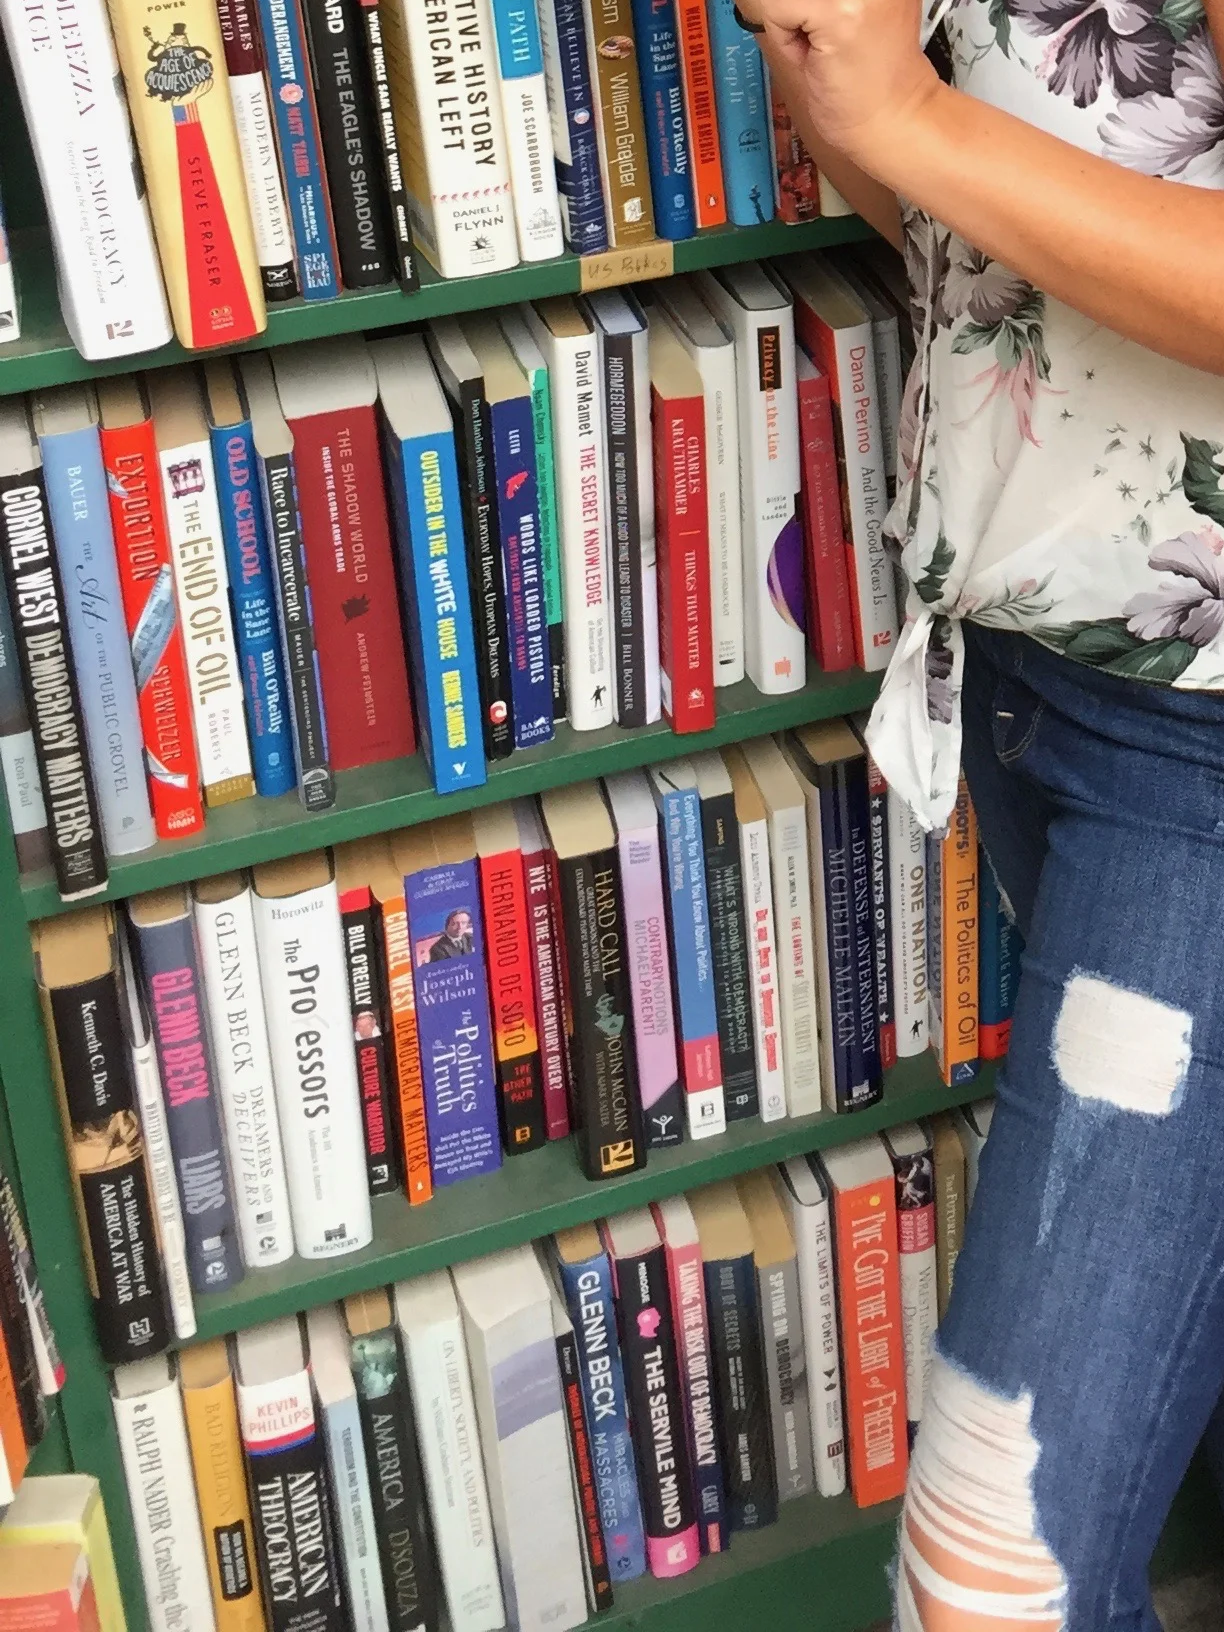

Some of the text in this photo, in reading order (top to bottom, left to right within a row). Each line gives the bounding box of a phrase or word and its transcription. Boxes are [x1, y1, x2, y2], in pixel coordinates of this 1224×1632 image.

[147, 1, 186, 13] POWER
[333, 48, 377, 251] THE EAGLE'S SHADOW
[437, 97, 465, 152] LEFT
[463, 64, 496, 168] HISTORY
[454, 216, 505, 232] FLYNN
[575, 350, 593, 437] David Mamet
[850, 345, 870, 454] Dana Perino
[2, 486, 59, 628] CORNEL WEST
[581, 446, 602, 607] THE SECRET KNOWLEDGE
[180, 500, 231, 705] THE END OF OIL
[26, 629, 94, 850] DEMOCRACY MATTERS
[271, 899, 325, 921] Horowitz
[152, 967, 210, 1107] GLENN BECK
[215, 913, 255, 1074] GLENN BECK
[100, 1183, 133, 1304] AMERICA AT WAR
[852, 1211, 897, 1471] I'VE GOT THE LIGHT of FREEDOM
[644, 1345, 682, 1529] THE SERVILE MIND
[257, 1478, 297, 1604] THEOCRACY
[288, 1473, 328, 1598] AMERICAN
